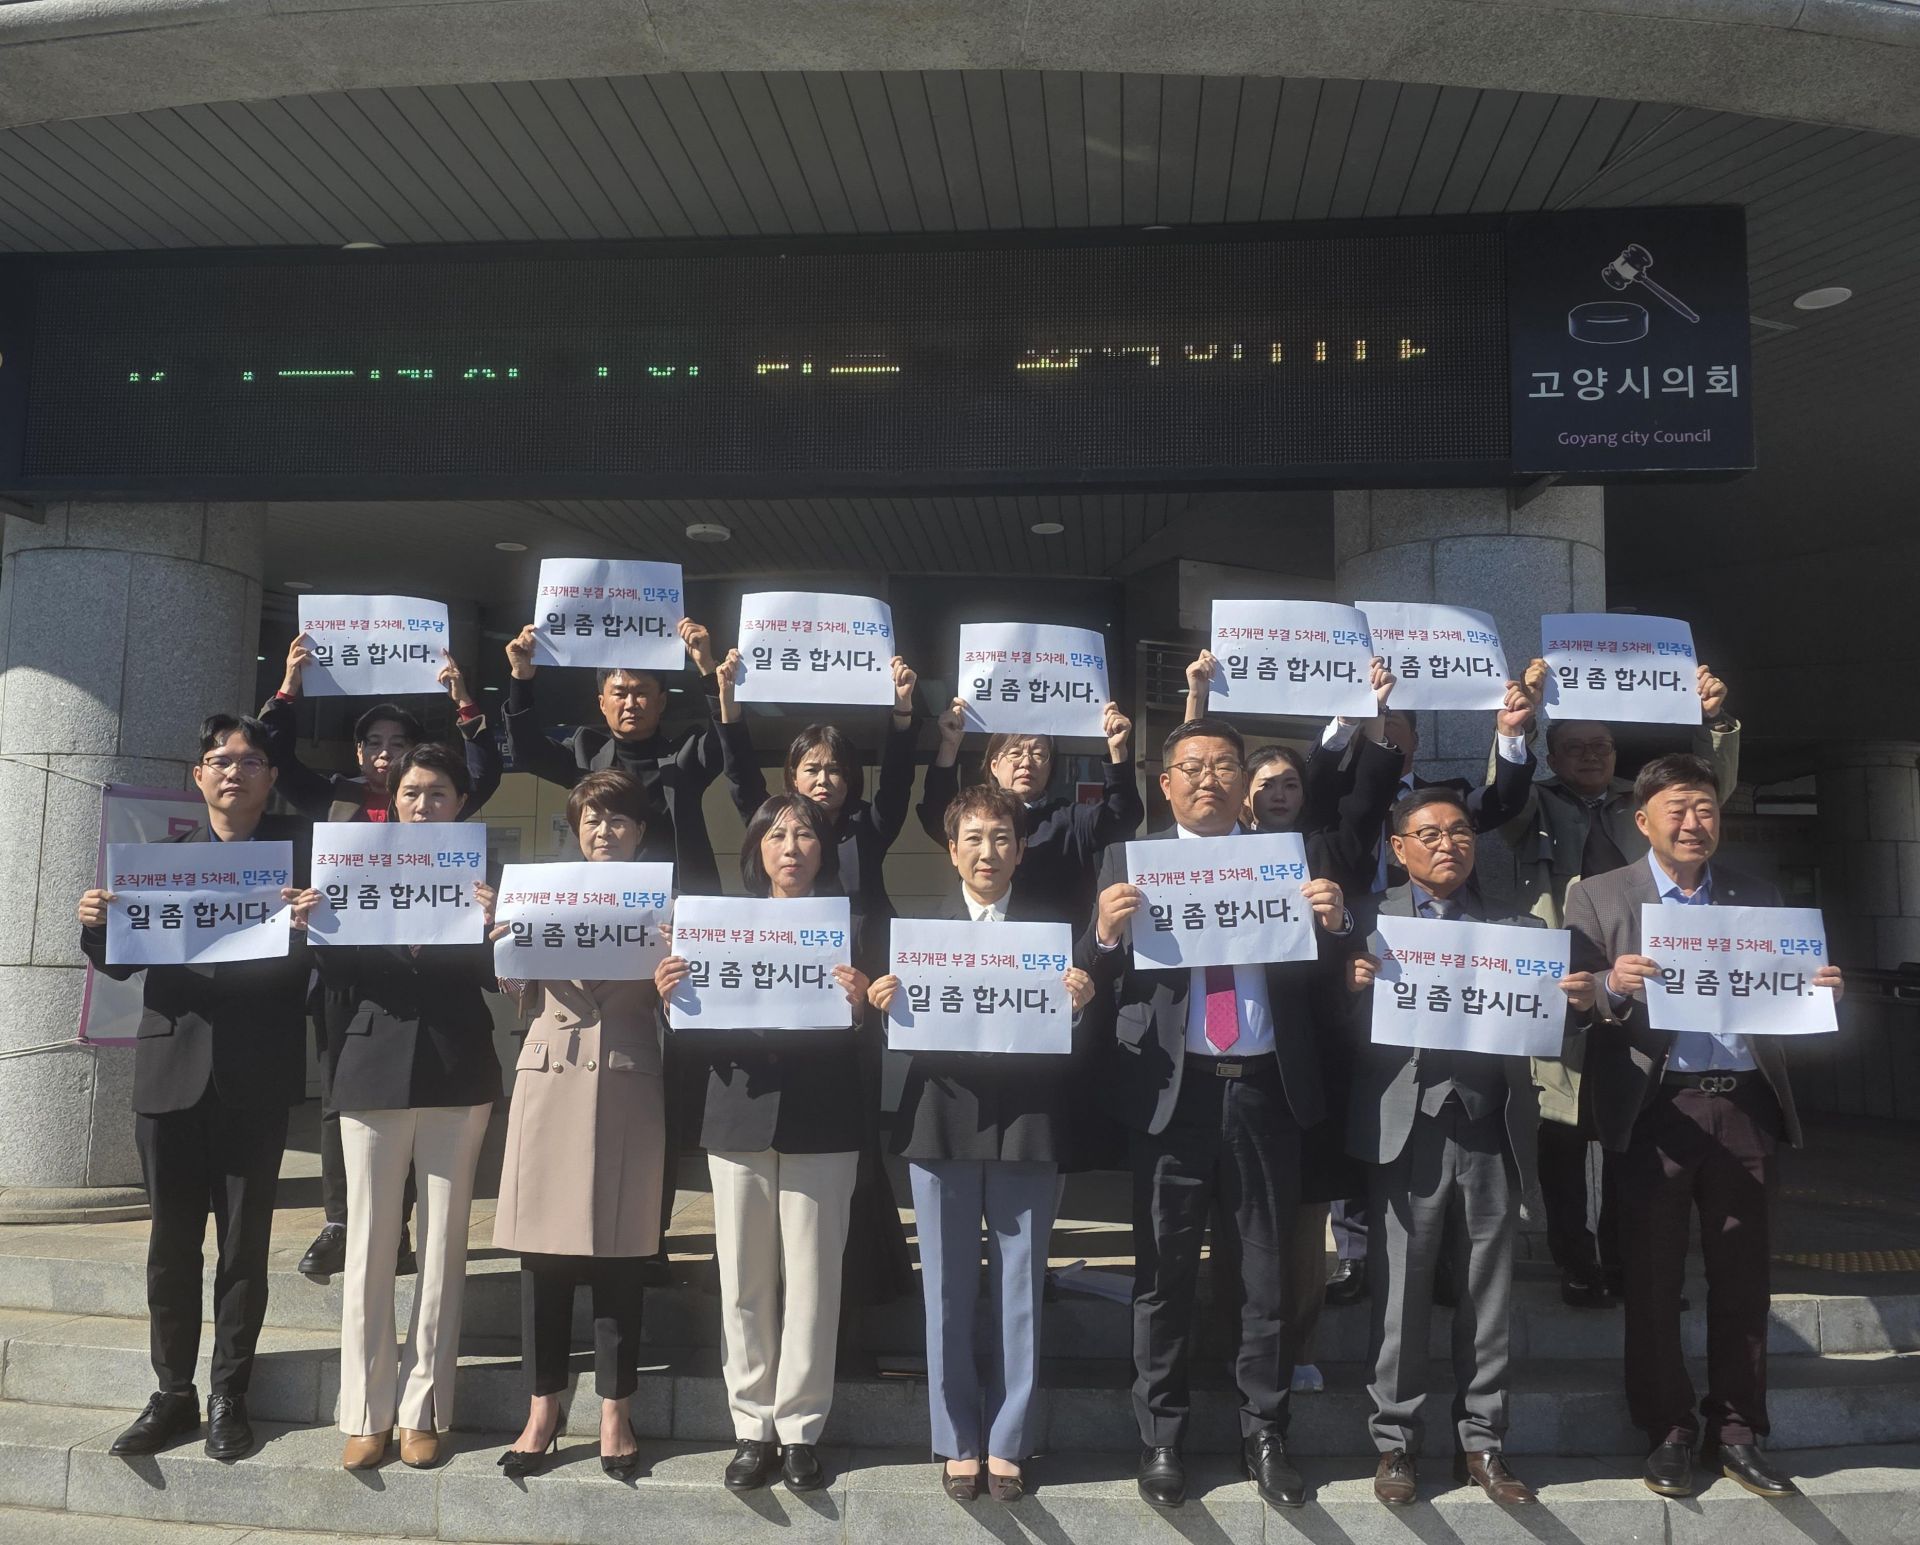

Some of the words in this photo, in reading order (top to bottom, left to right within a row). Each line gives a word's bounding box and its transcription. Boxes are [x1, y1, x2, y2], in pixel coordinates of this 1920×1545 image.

[1528, 364, 1739, 401] 고양시의회
[1557, 431, 1618, 448] Goyang
[1621, 430, 1650, 447] city
[1653, 428, 1711, 444] Council
[542, 586, 580, 599] 조직개편
[583, 586, 604, 599] 부결
[608, 586, 641, 601] 5차례,
[643, 587, 679, 602] 민주당
[305, 619, 345, 632] 조직개편
[349, 619, 369, 632] 부결
[374, 619, 405, 631] 5차례,
[408, 618, 444, 633] 민주당
[547, 613, 566, 635] 일
[575, 613, 595, 635] 좀
[602, 615, 672, 638] 합시다.
[745, 619, 787, 632] 조직개편
[791, 620, 812, 632] 부결
[817, 621, 850, 634] 5차례,
[852, 621, 890, 637] 민주당
[1218, 627, 1264, 641] 조직개편
[1268, 627, 1291, 642] 부결
[1295, 629, 1330, 645] 5차례,
[1332, 629, 1369, 648] 민주당
[1370, 628, 1405, 641] 직개편
[1408, 628, 1429, 642] 부결
[1433, 629, 1465, 645] 5차례,
[1467, 630, 1499, 648] 민주당
[1548, 639, 1593, 653] 조직개편
[1596, 640, 1618, 653] 부결
[1622, 641, 1655, 656] 5차례,
[1657, 641, 1692, 658] 민주당
[314, 645, 333, 667] 일
[341, 645, 360, 665] 좀
[367, 644, 435, 666] 합시다.
[752, 648, 772, 670] 일
[781, 648, 802, 669] 좀
[809, 648, 881, 672] 합시다.
[965, 651, 1007, 663] 조직개편
[1011, 651, 1032, 664] 부결
[1036, 651, 1068, 666] 5차례,
[1071, 651, 1103, 669] 민주당
[1399, 656, 1421, 678] 좀
[1428, 657, 1500, 677] 합시다.
[1227, 655, 1247, 681] 일
[1257, 656, 1279, 680] 좀
[1288, 657, 1363, 683] 합시다.
[1558, 666, 1578, 689] 일
[1586, 667, 1607, 689] 좀
[1615, 667, 1687, 693] 합시다.
[972, 679, 993, 701] 일
[1000, 679, 1021, 701] 좀
[1029, 679, 1099, 705] 합시다.
[317, 853, 364, 867] 조직개편
[368, 852, 392, 868] 부결
[397, 852, 434, 867] 5차례,
[436, 852, 481, 868] 민주당
[114, 871, 167, 887] 조직개편
[171, 871, 197, 885] 부결
[202, 871, 240, 885] 5차례,
[242, 869, 288, 886] 민주당
[1135, 871, 1186, 887] 조직개편
[1189, 870, 1214, 884] 부결
[1219, 868, 1257, 882] 5차례,
[1259, 863, 1305, 881] 민주당
[325, 884, 348, 911] 일
[357, 885, 381, 909] 좀
[389, 883, 470, 909] 합시다.
[503, 892, 551, 906] 조직개편
[554, 892, 578, 906] 부결
[582, 892, 619, 908] 5차례,
[622, 892, 667, 908] 민주당
[126, 904, 150, 931] 일
[159, 905, 184, 930] 좀
[193, 901, 276, 927] 합시다.
[1149, 903, 1173, 932] 일
[1182, 904, 1206, 930] 좀
[1216, 898, 1300, 927] 합시다.
[511, 922, 533, 948] 일
[542, 923, 566, 948] 좀
[574, 922, 655, 948] 합시다.
[676, 929, 727, 942] 조직개편
[730, 929, 754, 943] 부결
[759, 929, 797, 945] 5차례,
[799, 930, 845, 946] 민주당
[1649, 936, 1702, 950] 조직개편
[1706, 936, 1732, 953] 부결
[1736, 937, 1776, 954] 5차례,
[1779, 938, 1823, 957] 민주당
[896, 952, 947, 966] 조직개편
[951, 953, 976, 967] 부결
[980, 954, 1019, 970] 5차례,
[1022, 953, 1067, 972] 민주당
[1382, 949, 1436, 966] 조직개편
[1440, 952, 1467, 969] 부결
[1471, 954, 1511, 974] 5차례,
[1515, 957, 1565, 979] 민주당
[688, 961, 711, 988] 일
[719, 962, 743, 989] 좀
[751, 961, 834, 989] 합시다.
[1662, 967, 1686, 995] 일
[1694, 969, 1720, 996] 좀
[1728, 969, 1814, 997] 합시다.
[908, 985, 931, 1012] 일
[940, 986, 964, 1013] 좀
[972, 985, 1055, 1015] 합시다.
[1393, 983, 1418, 1010] 일
[1426, 985, 1452, 1012] 좀
[1461, 986, 1549, 1019] 합시다.
